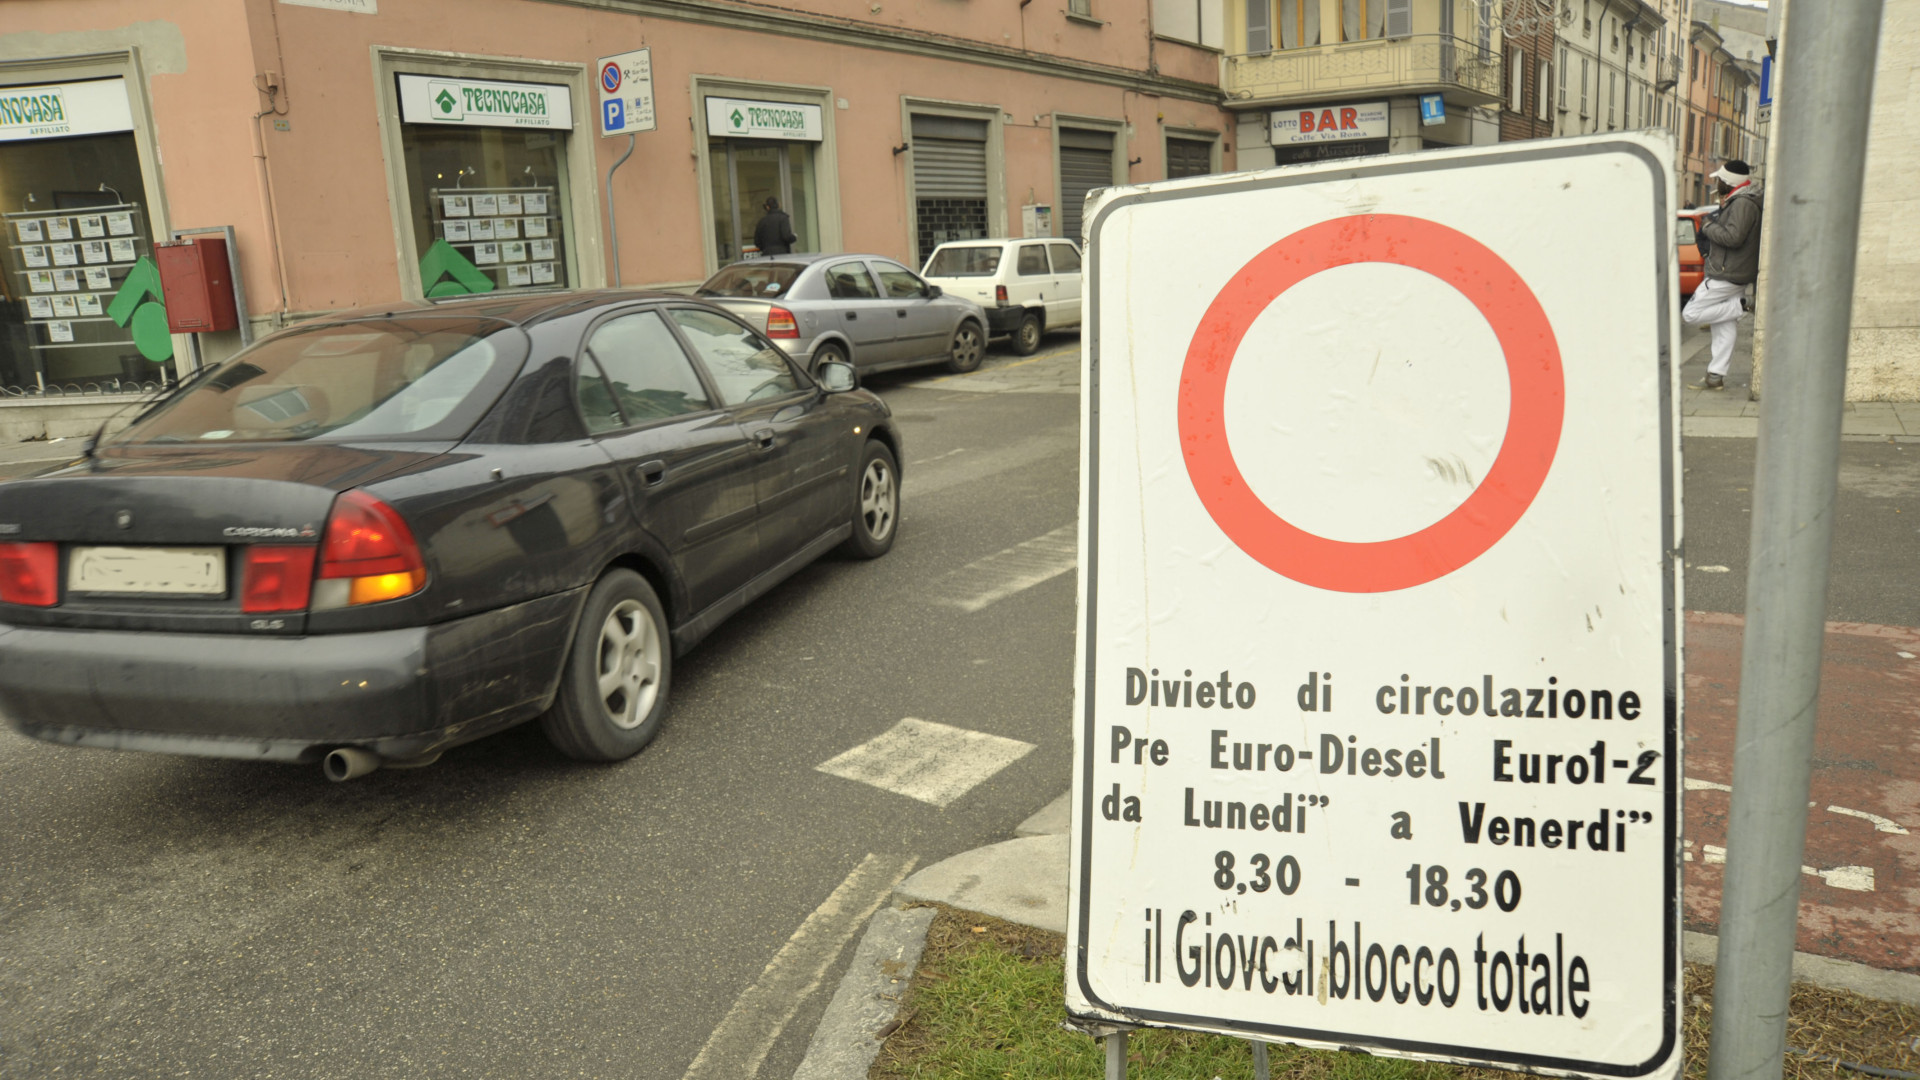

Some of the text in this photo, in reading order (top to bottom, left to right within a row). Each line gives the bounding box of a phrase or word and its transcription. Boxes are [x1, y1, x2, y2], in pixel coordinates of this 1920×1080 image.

[0, 94, 64, 125] NOCASA
[462, 87, 546, 115] TECNOCASA
[608, 102, 620, 125] P
[29, 126, 70, 134] AFFILIATO
[748, 107, 804, 129] TECNOCASA
[1273, 119, 1298, 129] LOTTO
[1299, 107, 1359, 133] BAR
[1320, 132, 1336, 140] Via
[1340, 131, 1367, 139] Roma
[1127, 668, 1641, 721] Divieto di circolazione
[1112, 726, 1661, 786] Pre Euro-Diesel Euro1-2
[1101, 784, 1142, 823] da
[1390, 811, 1413, 841] a
[1213, 851, 1301, 896] 8,30
[1406, 864, 1522, 913] 18,30
[1145, 908, 1162, 984] il
[1329, 920, 1461, 1009] blocco
[1474, 930, 1590, 1020] totale
